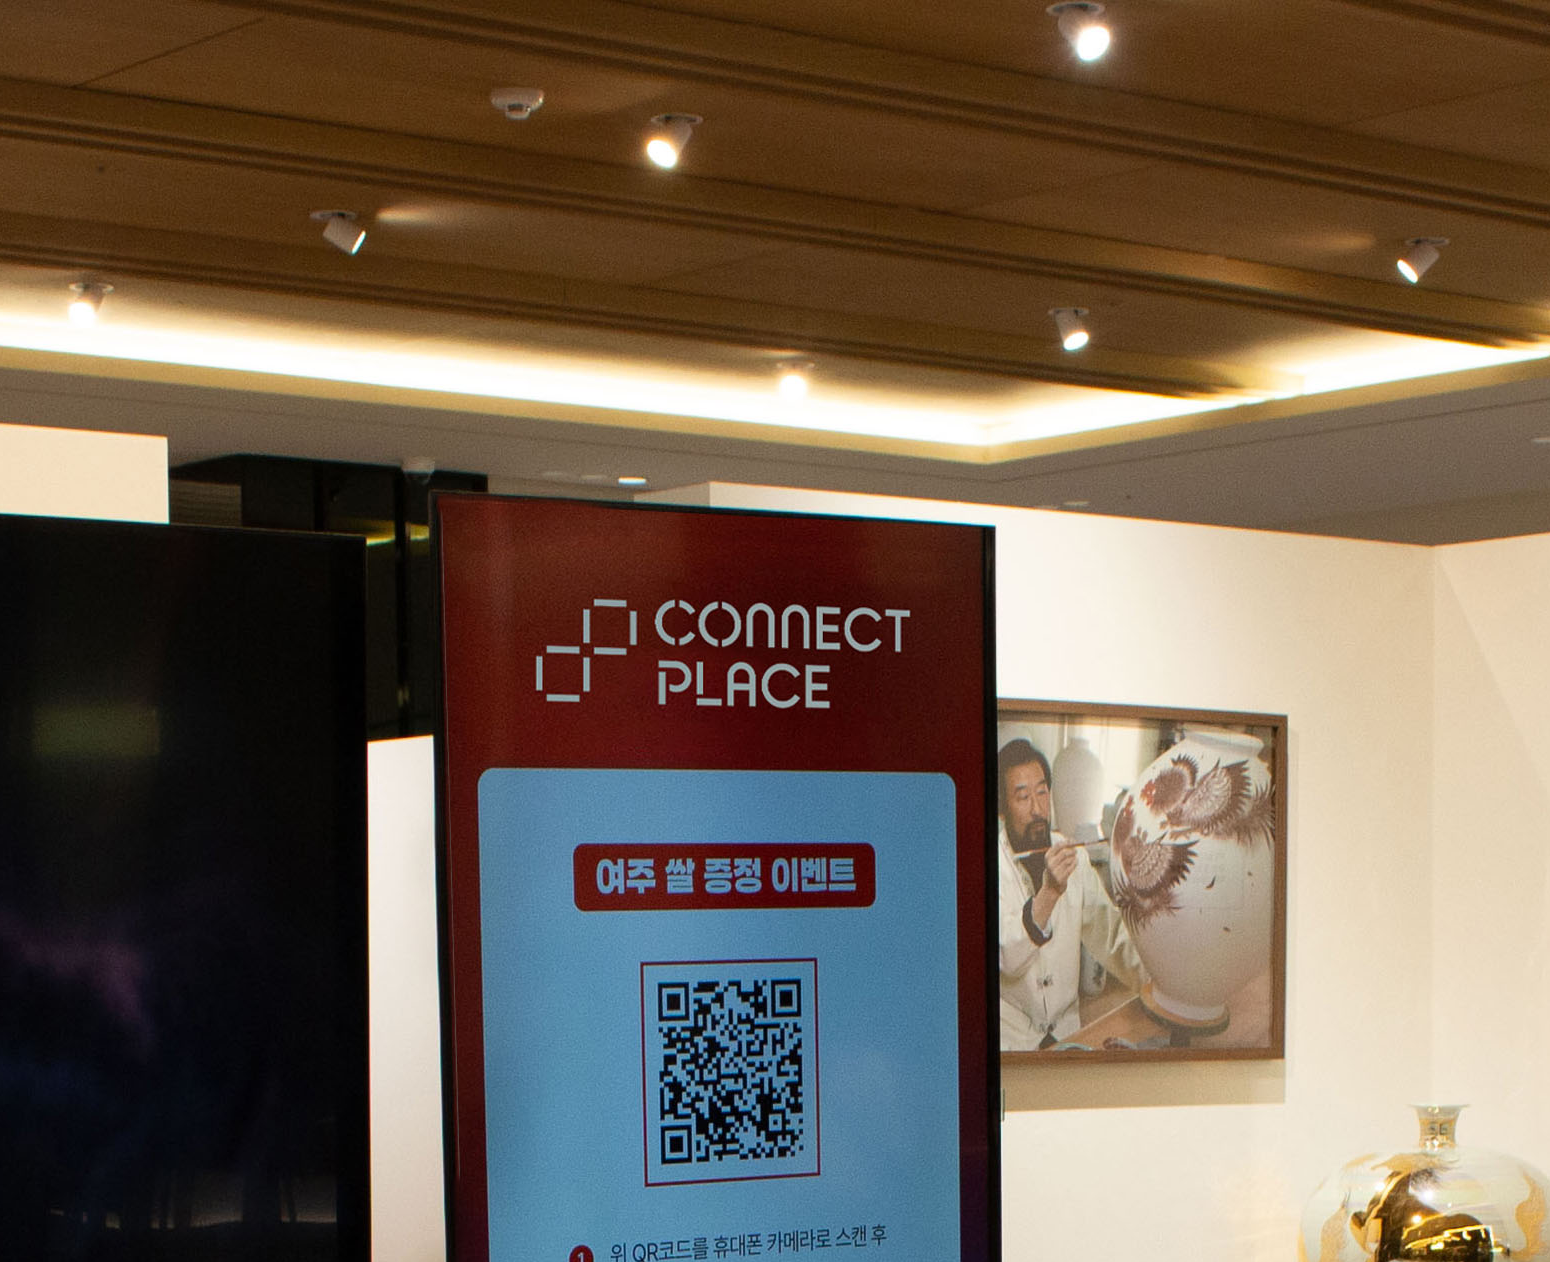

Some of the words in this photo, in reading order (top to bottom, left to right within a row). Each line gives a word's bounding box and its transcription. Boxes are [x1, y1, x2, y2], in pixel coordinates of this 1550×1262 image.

[654, 599, 911, 653] CONNECT
[657, 659, 830, 709] PLACE
[595, 858, 656, 894] 여주
[664, 857, 696, 894] 쌀
[703, 857, 762, 894] 증정
[771, 857, 856, 892] 이벤트
[712, 1232, 763, 1259] 휴대폰
[766, 1228, 832, 1254] 카메라로
[835, 1224, 867, 1248] 스캔
[870, 1223, 887, 1246] 후
